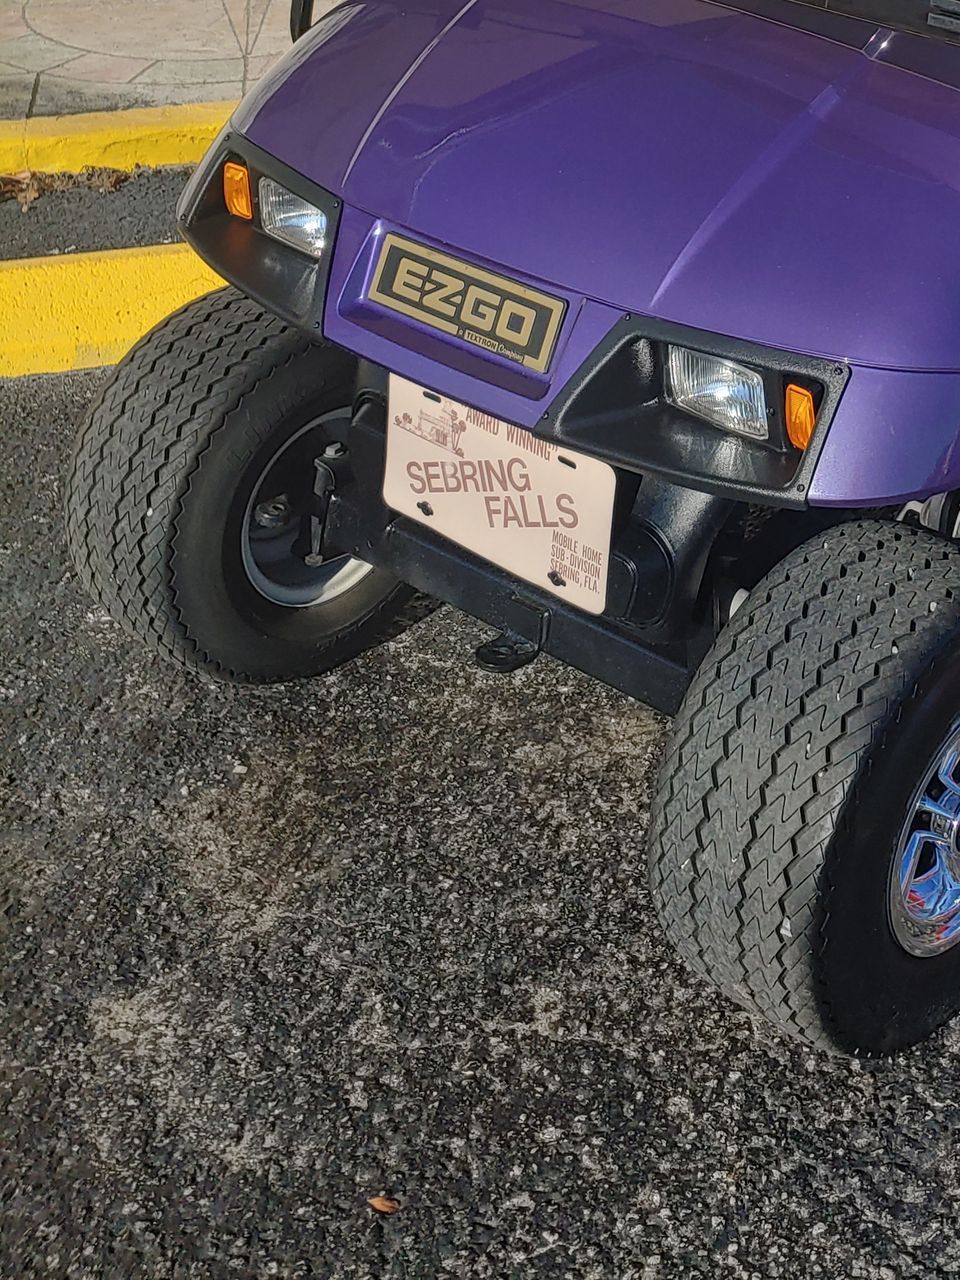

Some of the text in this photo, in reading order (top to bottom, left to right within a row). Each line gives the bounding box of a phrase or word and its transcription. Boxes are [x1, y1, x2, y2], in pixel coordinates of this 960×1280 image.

[466, 331, 497, 351] TEXTRON
[406, 457, 532, 494] SEBRING
[484, 493, 579, 529] FALLS
[552, 529, 603, 566] MOBILE HOME
[584, 575, 600, 594] FLA.
